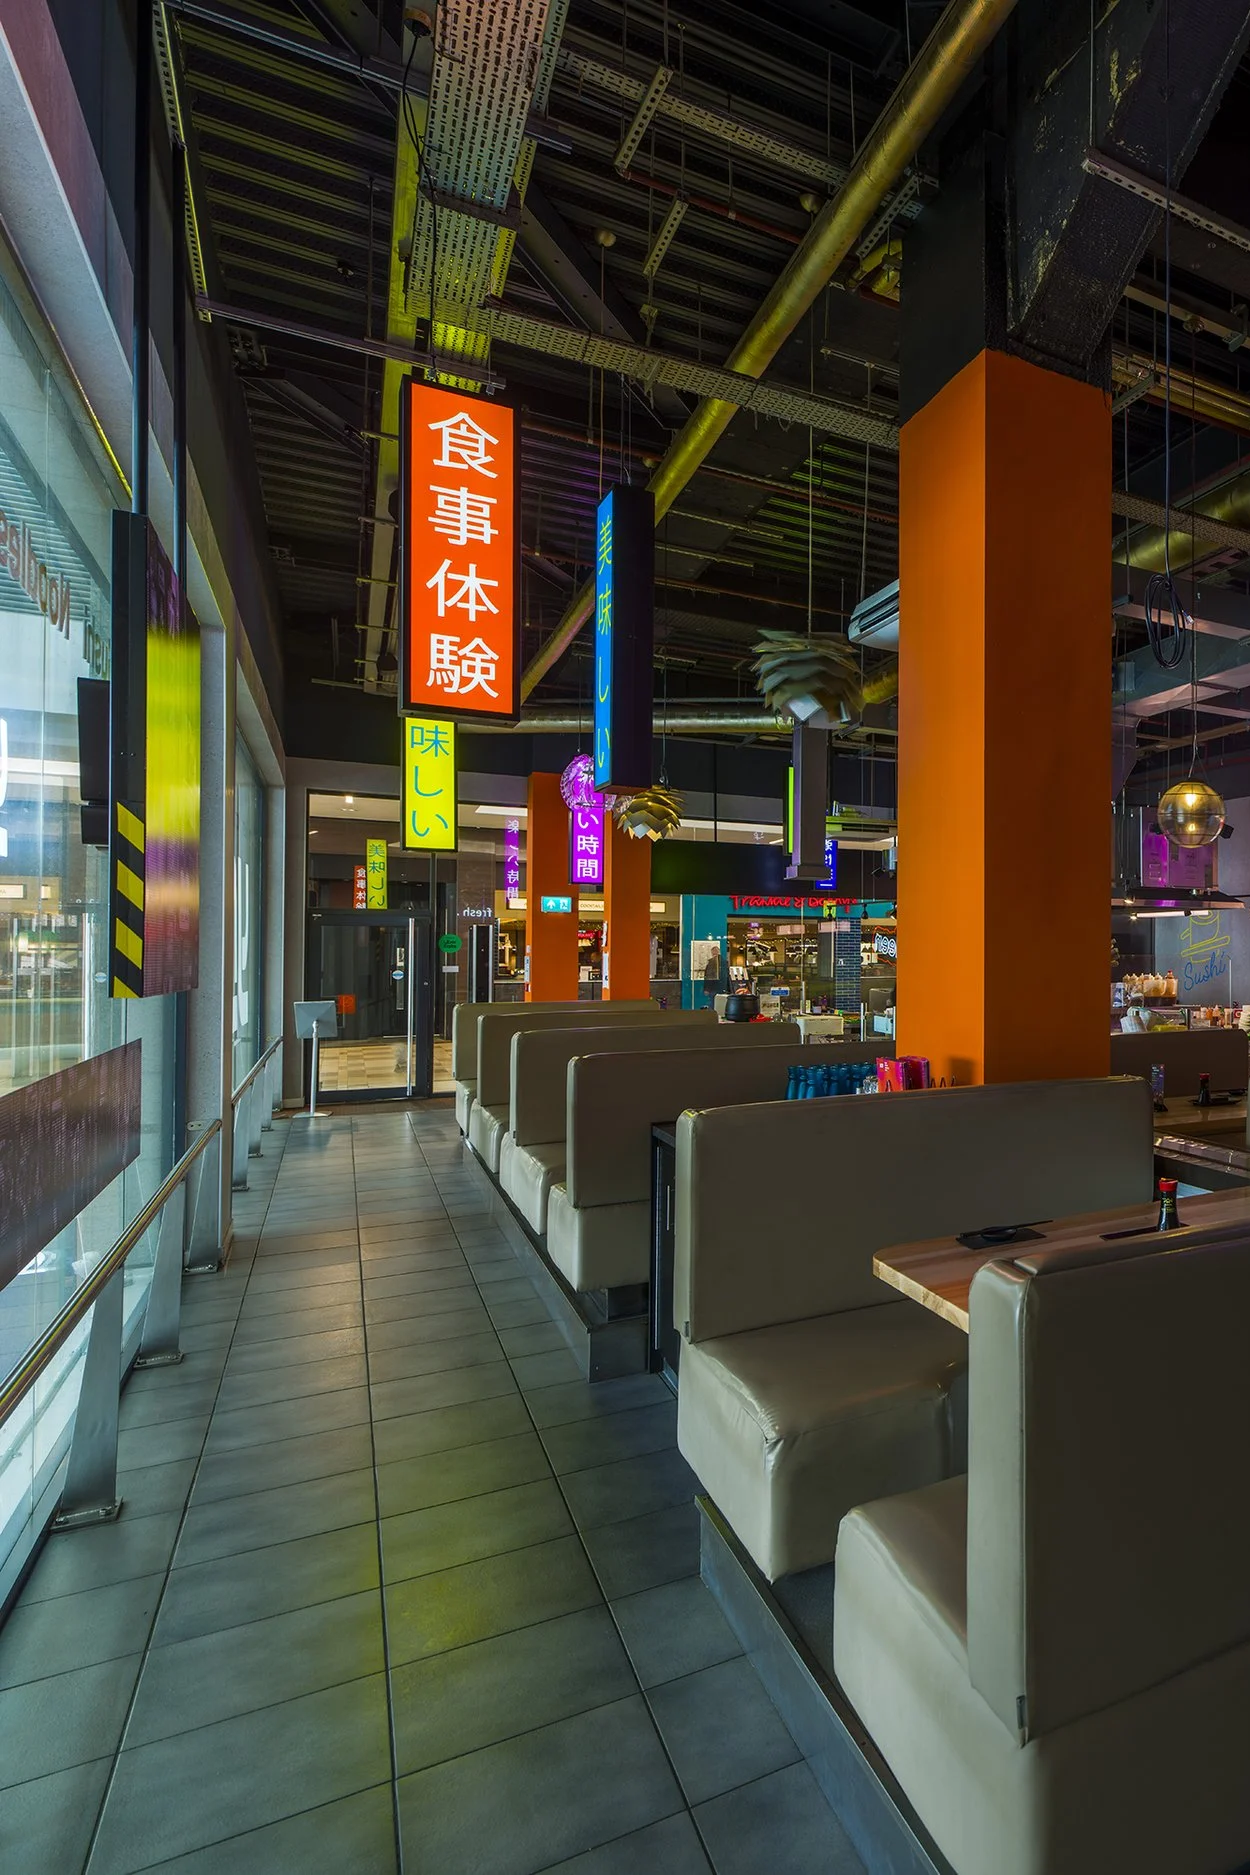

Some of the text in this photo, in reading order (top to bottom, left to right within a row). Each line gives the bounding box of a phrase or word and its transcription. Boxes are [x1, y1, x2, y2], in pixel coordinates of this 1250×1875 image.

[426, 411, 499, 698] 食事体験
[598, 515, 612, 768] 美味しい
[1184, 951, 1226, 991] Sushi
